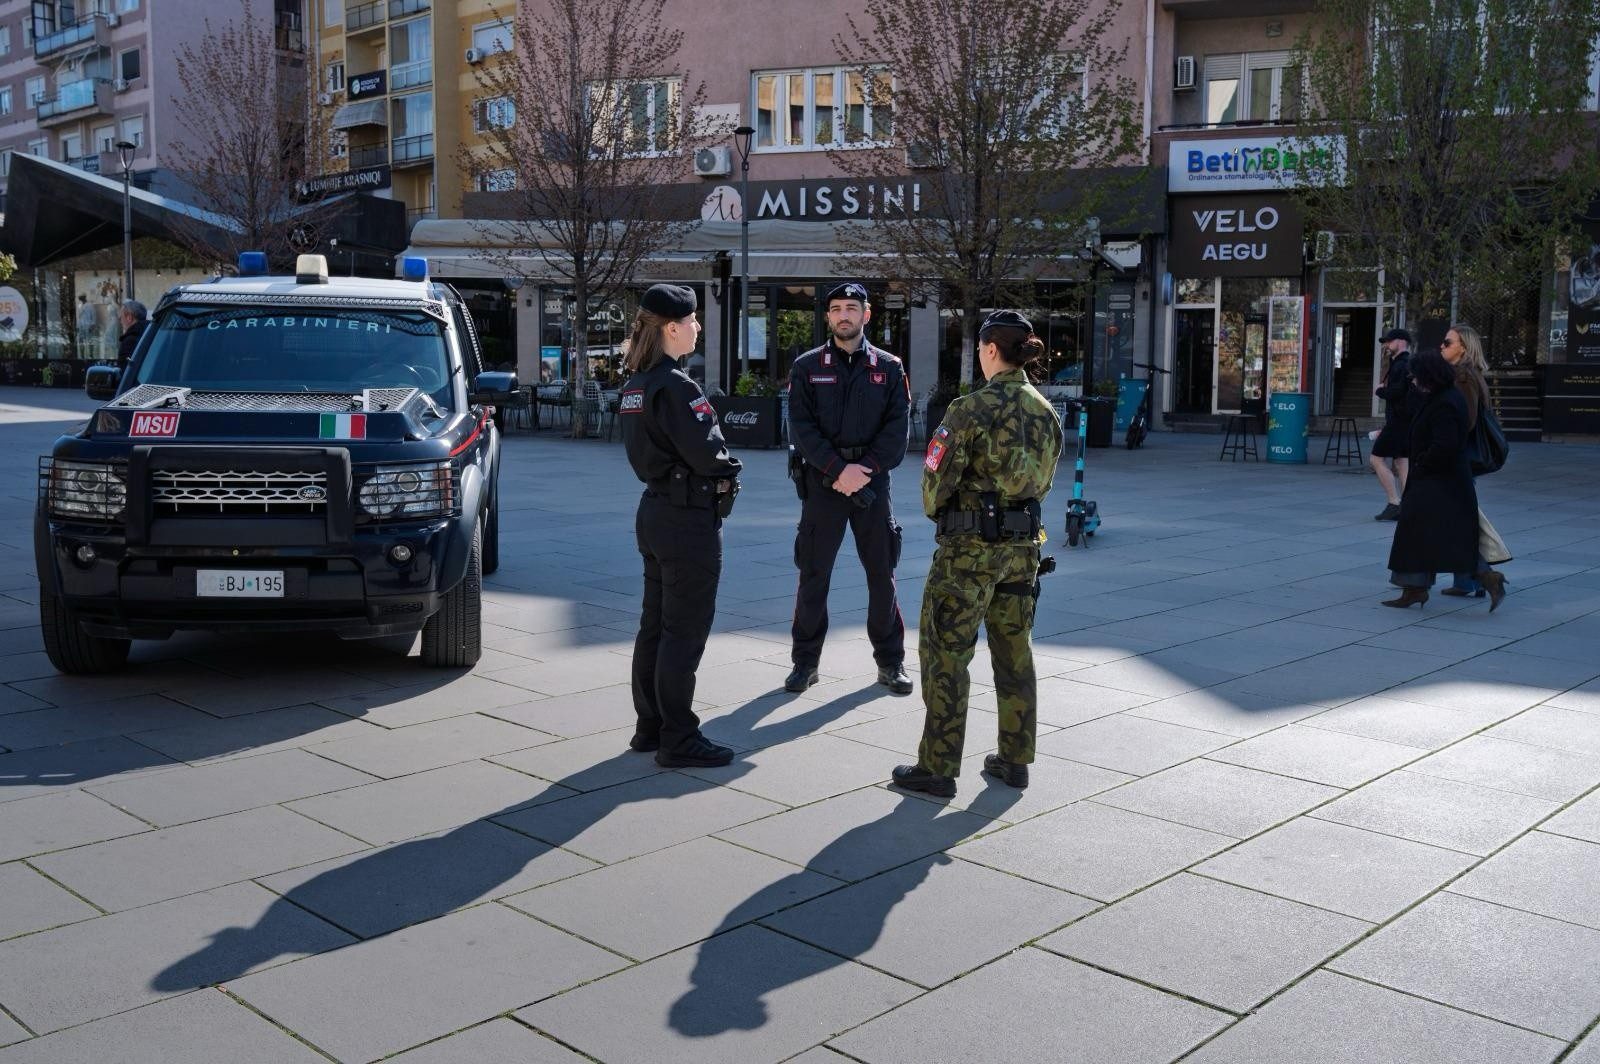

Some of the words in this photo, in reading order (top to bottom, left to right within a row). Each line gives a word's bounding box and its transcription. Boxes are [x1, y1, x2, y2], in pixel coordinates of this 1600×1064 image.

[1187, 148, 1238, 173] Beti
[1188, 173, 1223, 181] Ordinanca
[757, 183, 920, 217] MISSINI
[1192, 206, 1279, 232] VELO
[1202, 243, 1267, 260] AEGU
[207, 317, 391, 334] CARABINIERI
[135, 416, 176, 434] MSU
[226, 577, 245, 591] BJ
[255, 577, 282, 591] 195
